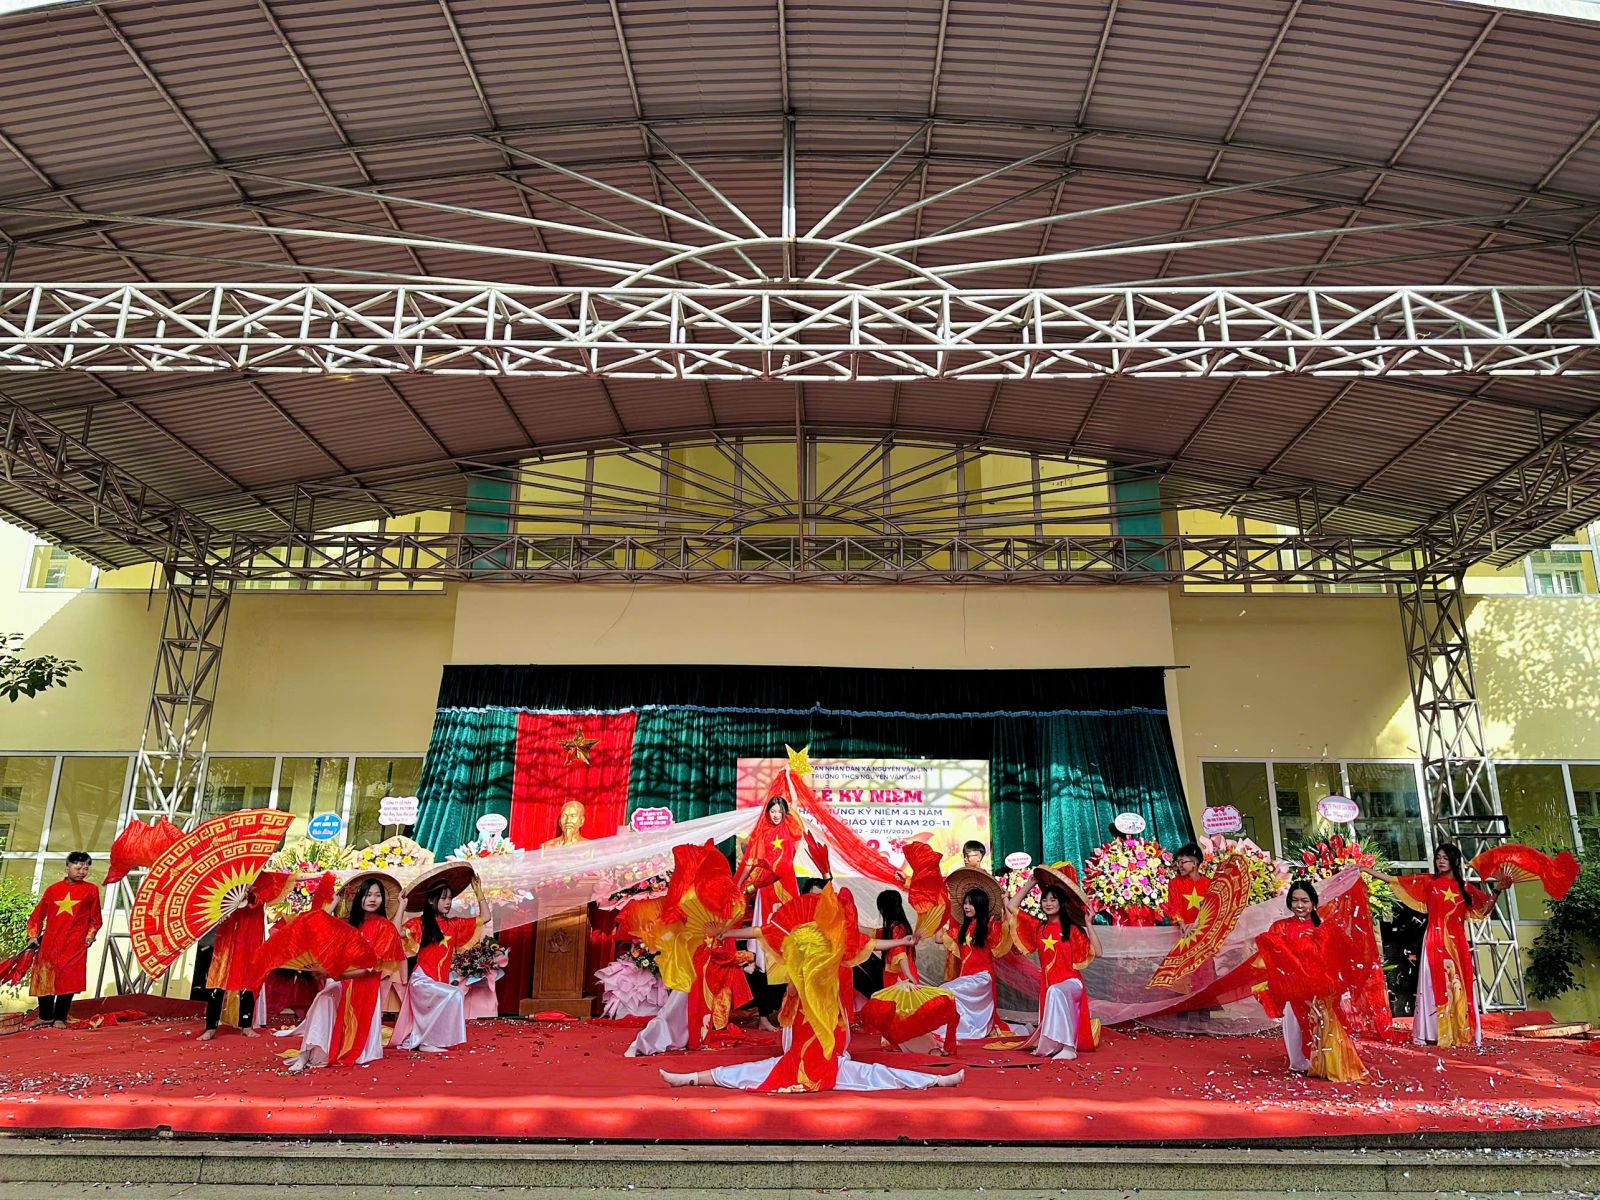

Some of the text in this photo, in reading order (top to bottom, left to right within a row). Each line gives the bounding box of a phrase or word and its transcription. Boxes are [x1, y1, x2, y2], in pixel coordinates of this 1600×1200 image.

[839, 785, 865, 803] KỶ
[869, 786, 923, 806] NIỆM
[857, 806, 872, 816] KỶ
[874, 807, 900, 817] NIỆM
[902, 808, 917, 816] 43
[918, 807, 943, 816] NĂM
[842, 817, 867, 826] GIÁO
[869, 818, 893, 828] VIỆT
[922, 819, 950, 827] 20-11
